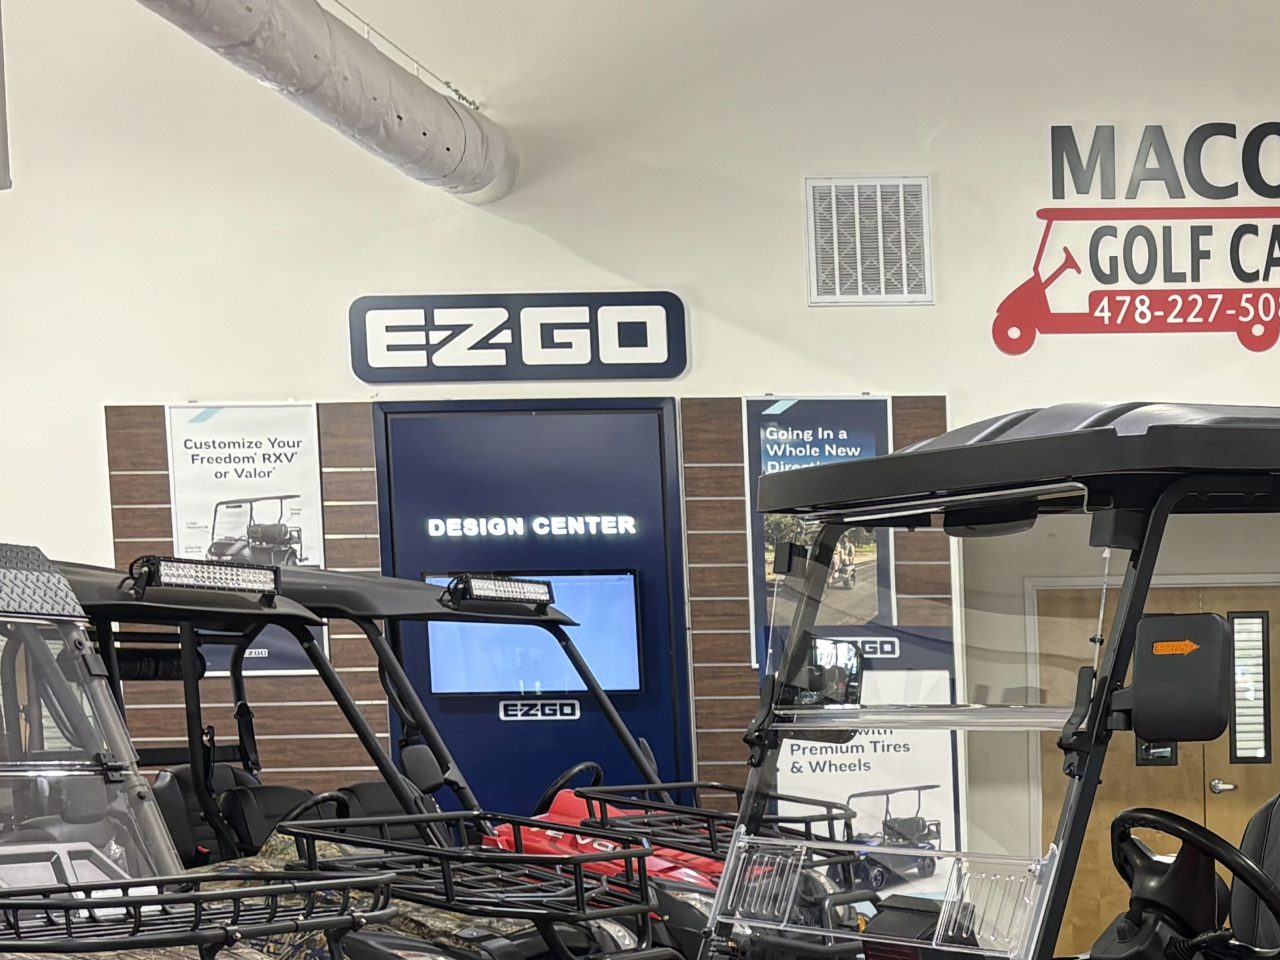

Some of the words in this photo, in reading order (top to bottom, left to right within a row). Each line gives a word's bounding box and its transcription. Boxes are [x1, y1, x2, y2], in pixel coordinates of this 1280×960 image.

[1088, 225, 1213, 285] GOLF
[765, 427, 813, 442] Going
[818, 427, 834, 439] In
[838, 429, 848, 440] a
[184, 438, 263, 450] Customize
[267, 437, 303, 449] Your
[766, 444, 820, 457] Whole
[825, 444, 861, 457] New
[214, 470, 229, 479] or
[428, 517, 524, 537] DESIGN
[532, 515, 637, 535] CENTER
[790, 742, 865, 756] Premium
[870, 740, 911, 753] Tires
[790, 761, 803, 774] &
[808, 759, 872, 773] Wheels
